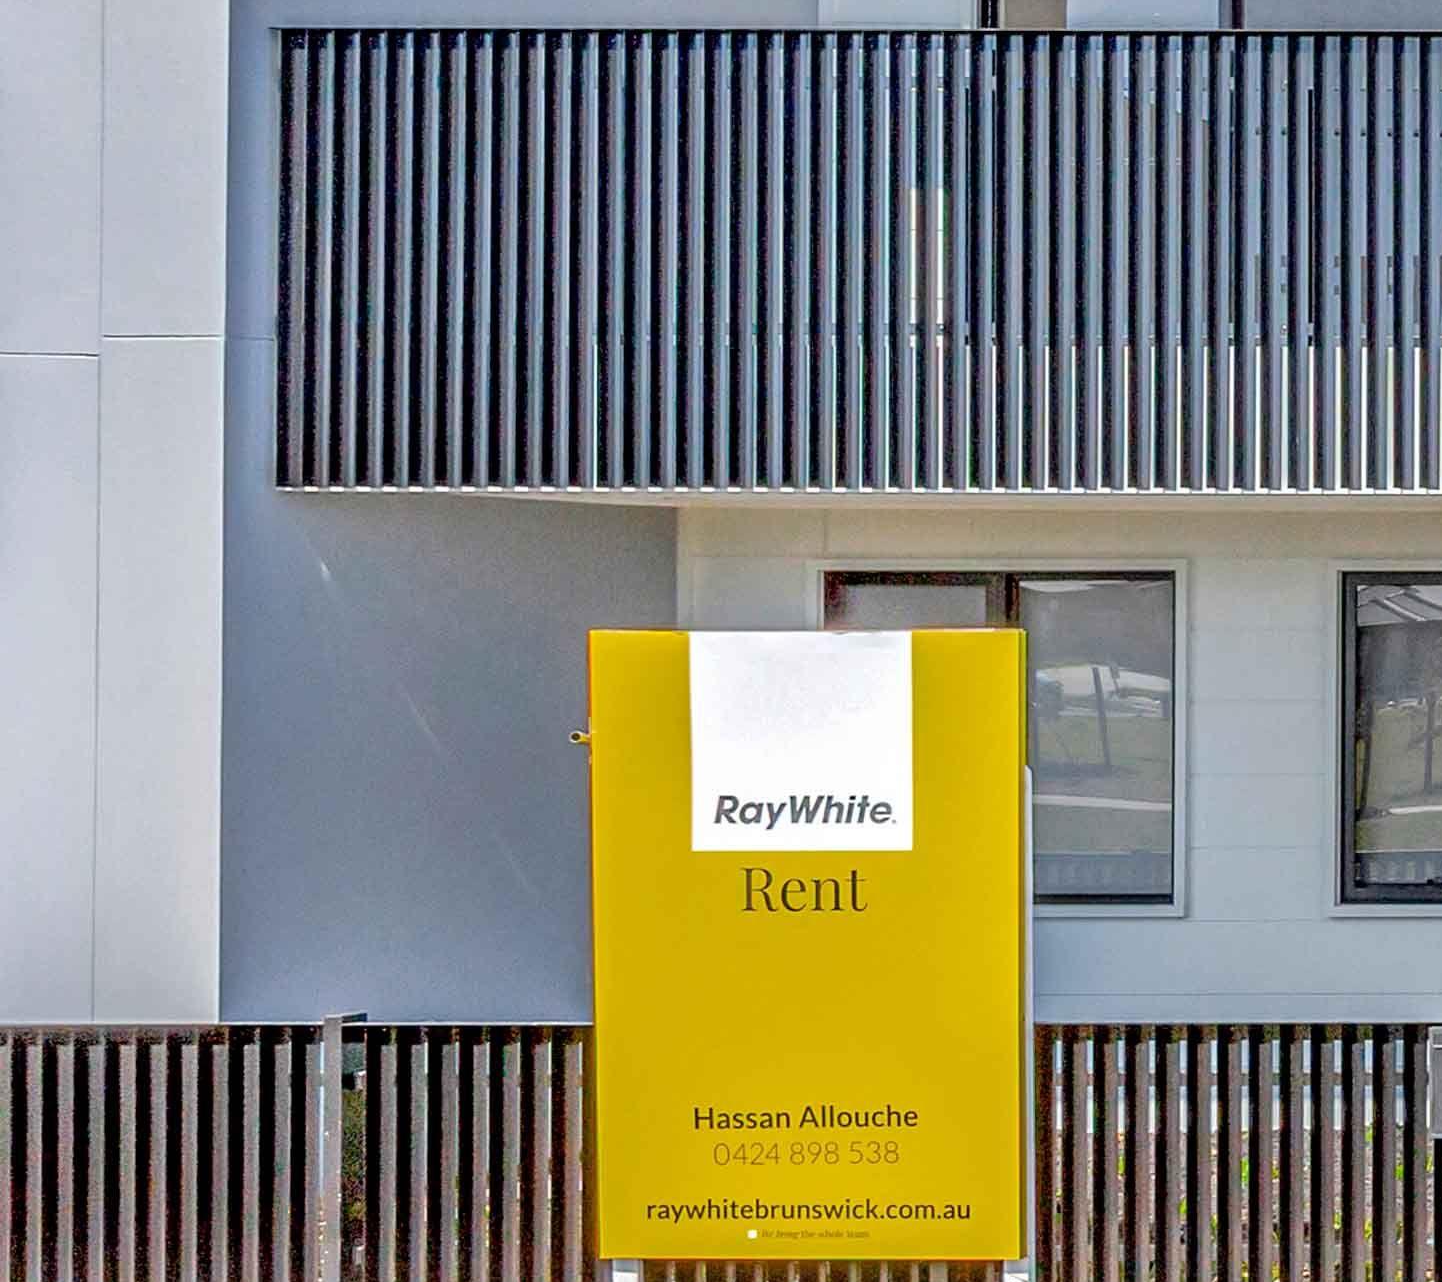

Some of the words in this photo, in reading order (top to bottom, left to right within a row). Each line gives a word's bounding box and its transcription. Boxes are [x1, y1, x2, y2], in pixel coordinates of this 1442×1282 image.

[740, 867, 869, 913] Rent
[693, 1107, 791, 1130] Hassan
[798, 1105, 919, 1129] Allouche
[712, 1142, 780, 1166] 0424
[789, 1141, 840, 1165] 898
[849, 1140, 900, 1164] 538
[646, 1198, 971, 1224] raywhitebrunswick.com.au
